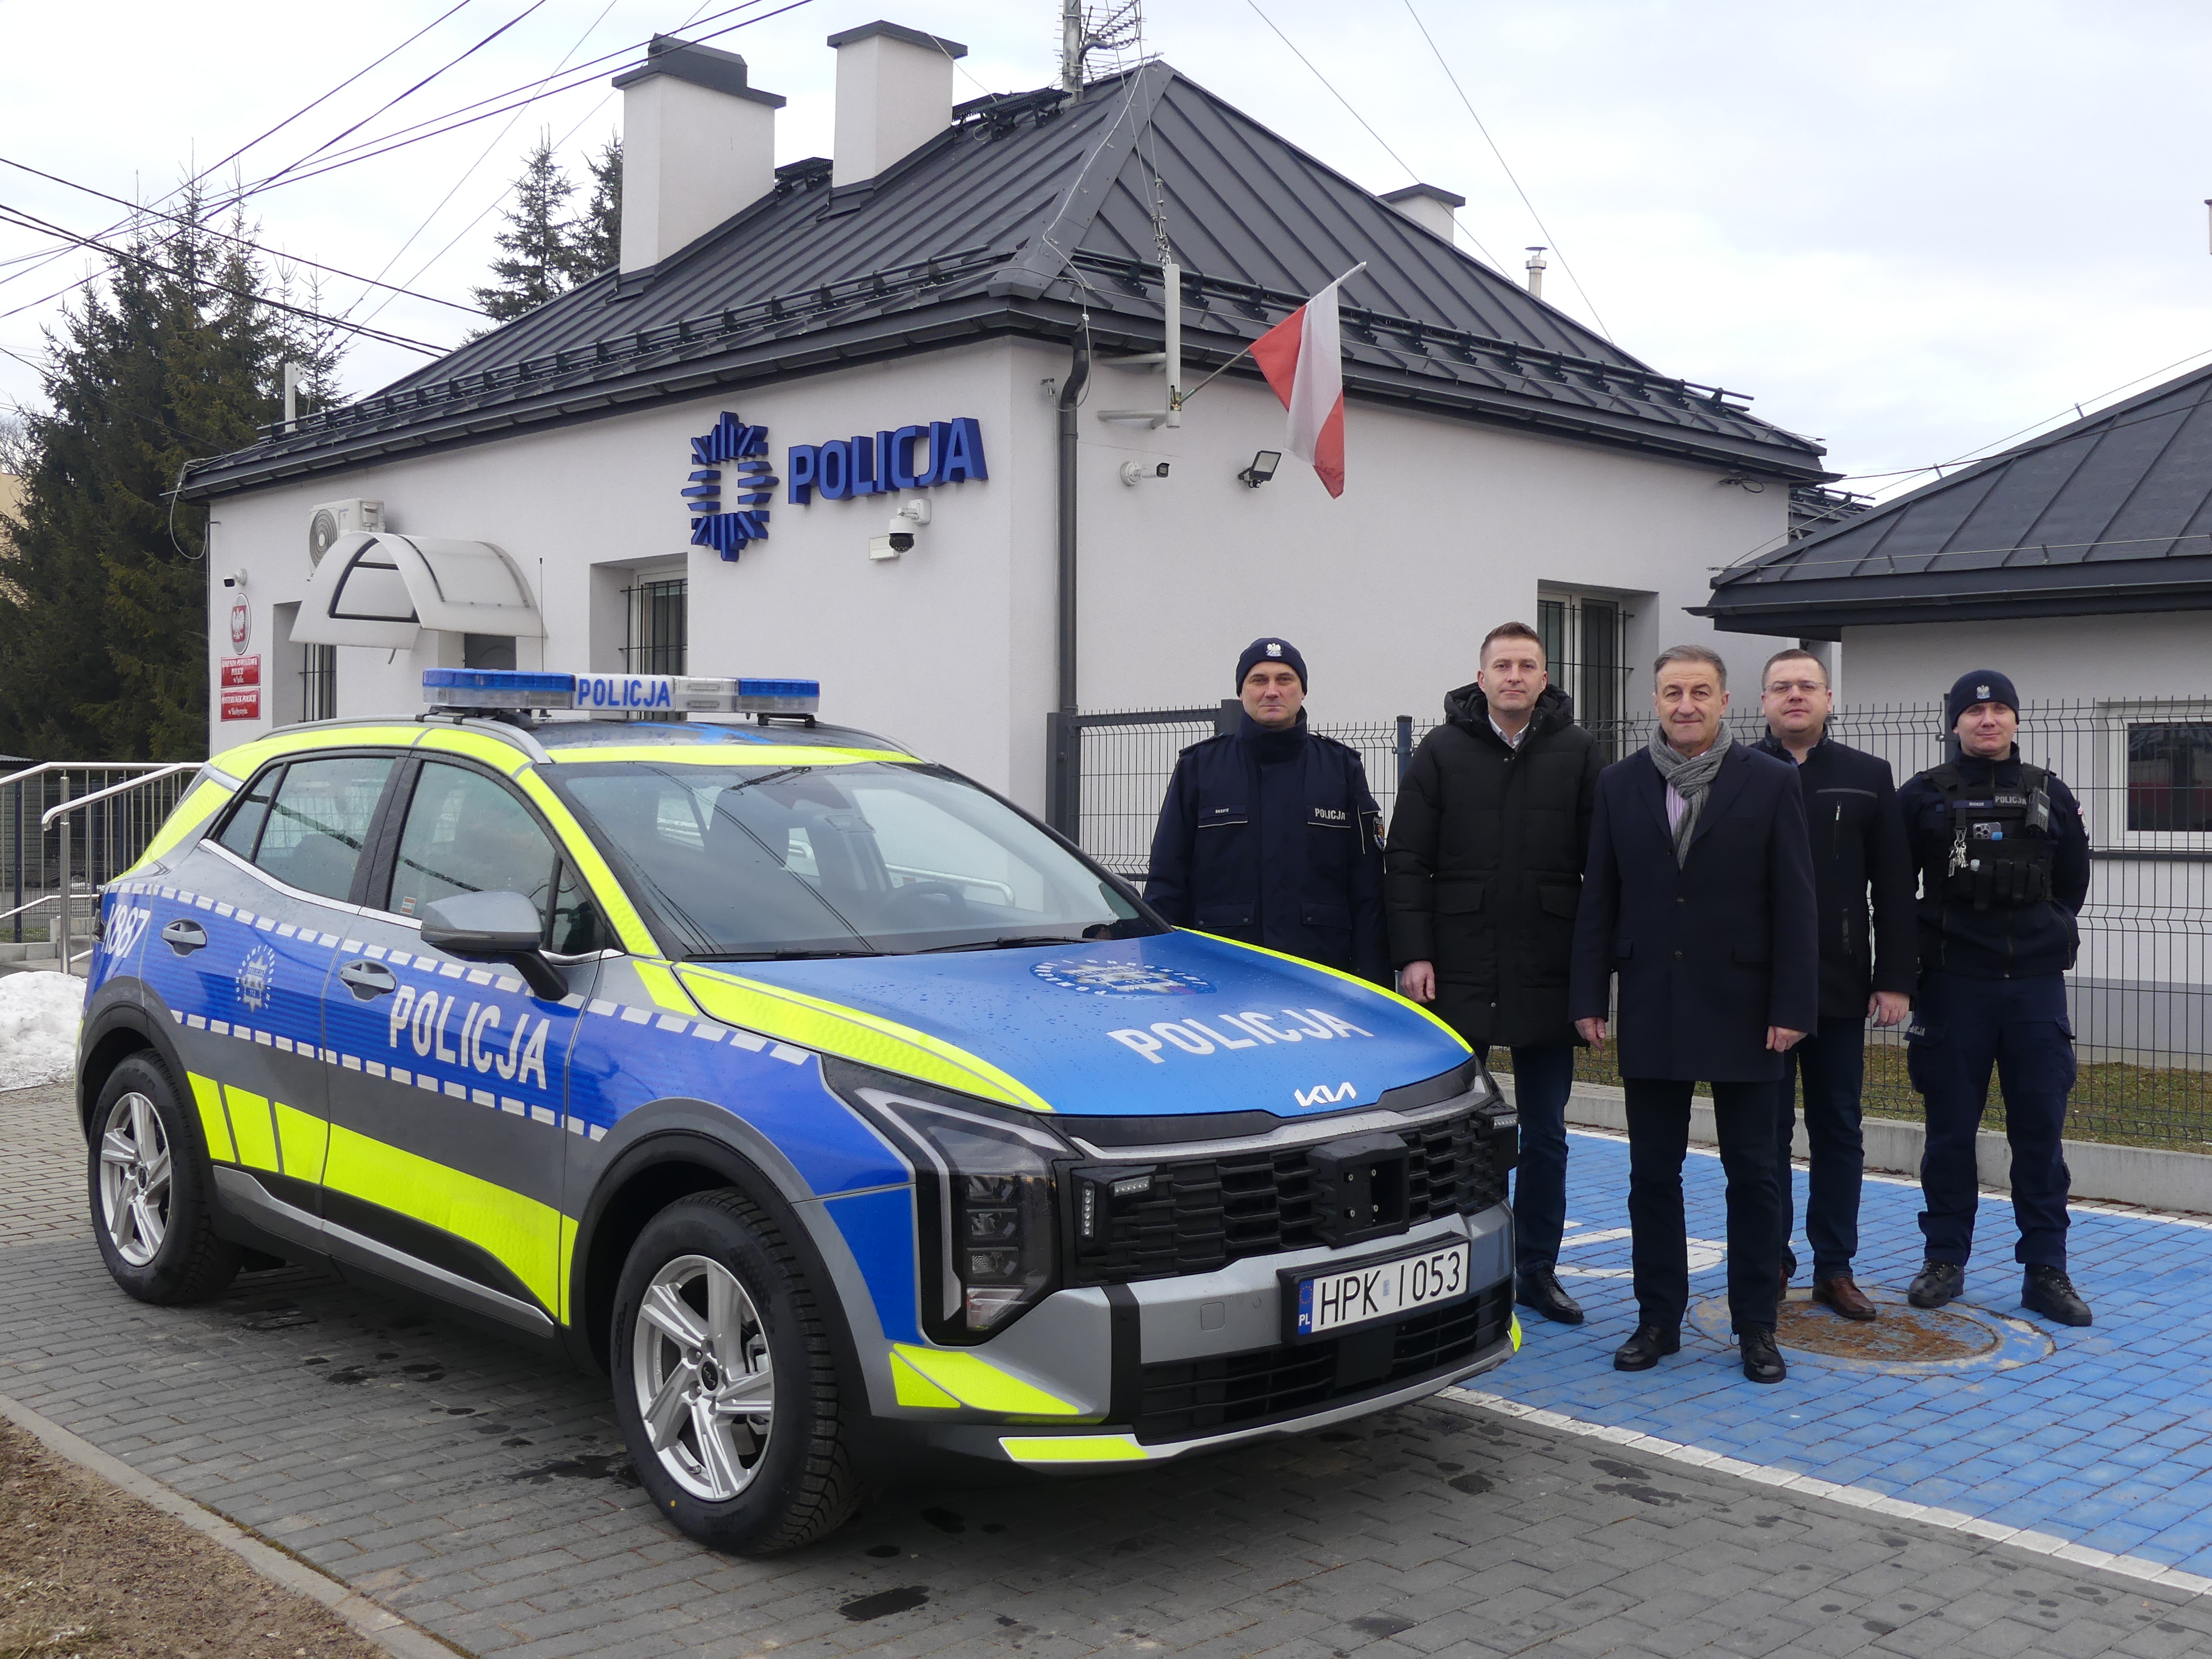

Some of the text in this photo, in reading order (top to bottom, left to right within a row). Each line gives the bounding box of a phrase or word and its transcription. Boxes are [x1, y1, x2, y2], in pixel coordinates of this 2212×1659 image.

[789, 418, 988, 504] POLICJA
[578, 679, 671, 707] POLICJA
[1314, 808, 1345, 820] POLICJA
[1995, 796, 2027, 805] POLICJA
[390, 985, 550, 1089] POLICJA
[1107, 1009, 1374, 1064] POLICJA
[1293, 1082, 1357, 1107] KIA
[1320, 1269, 1381, 1326] HPK
[1298, 1313, 1311, 1327] PL
